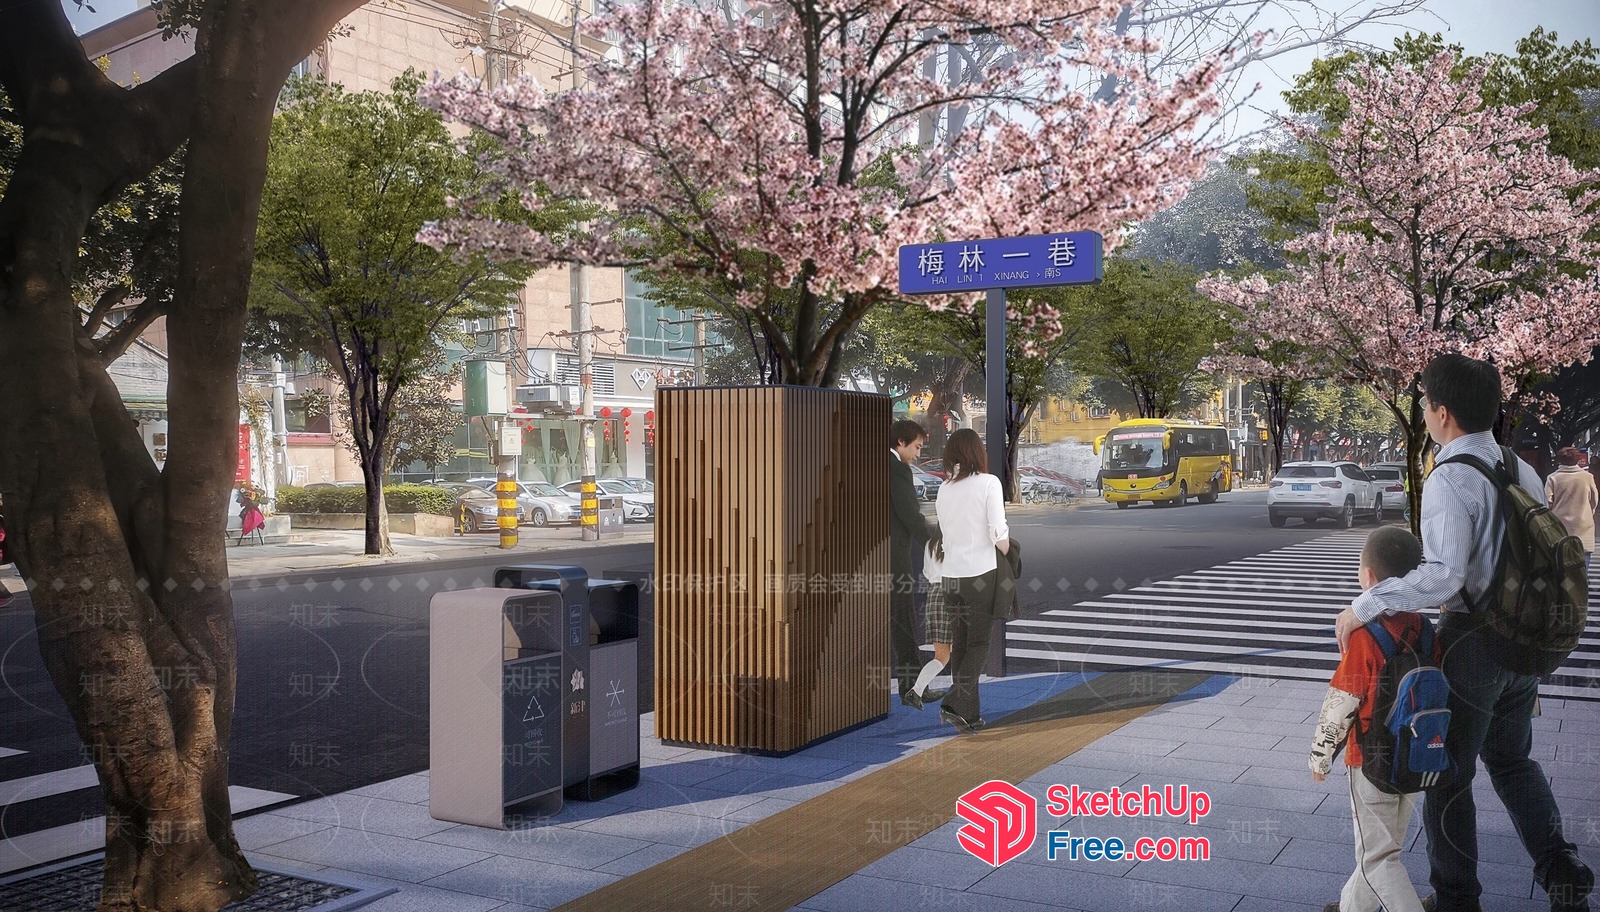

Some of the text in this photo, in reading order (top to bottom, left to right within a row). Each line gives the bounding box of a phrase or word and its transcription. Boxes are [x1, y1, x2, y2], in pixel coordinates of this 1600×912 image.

[917, 237, 1075, 276] 梅林一巷
[931, 276, 948, 285] HAI
[957, 274, 973, 283] LIN
[994, 270, 1029, 281] XINANG
